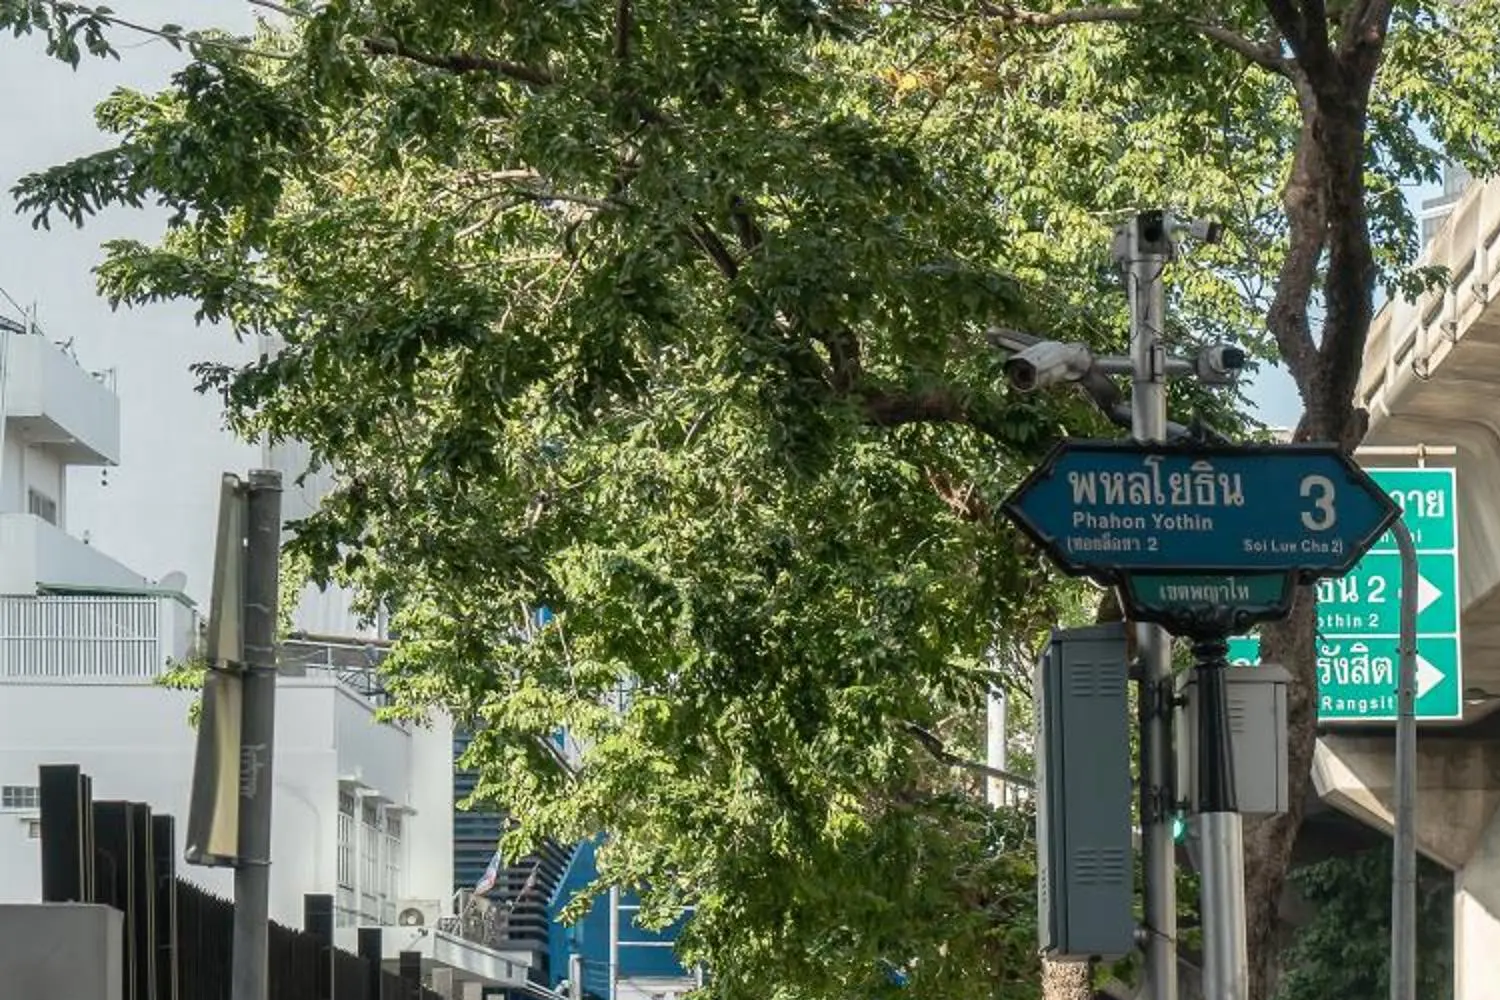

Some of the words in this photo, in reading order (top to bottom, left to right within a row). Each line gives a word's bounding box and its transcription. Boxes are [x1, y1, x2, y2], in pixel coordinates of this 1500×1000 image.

[1068, 455, 1245, 508] พหลโยธิน
[1299, 474, 1336, 532] 3
[1072, 511, 1146, 530] Phahon
[1151, 513, 1214, 531] Yothin
[1147, 536, 1160, 552] 2
[1244, 539, 1267, 552] Soi
[1301, 539, 1329, 553] Cha
[1367, 575, 1387, 604] 2
[1368, 613, 1380, 628] 2
[1317, 641, 1394, 685] รังสิต
[1321, 695, 1395, 714] Rangsit
